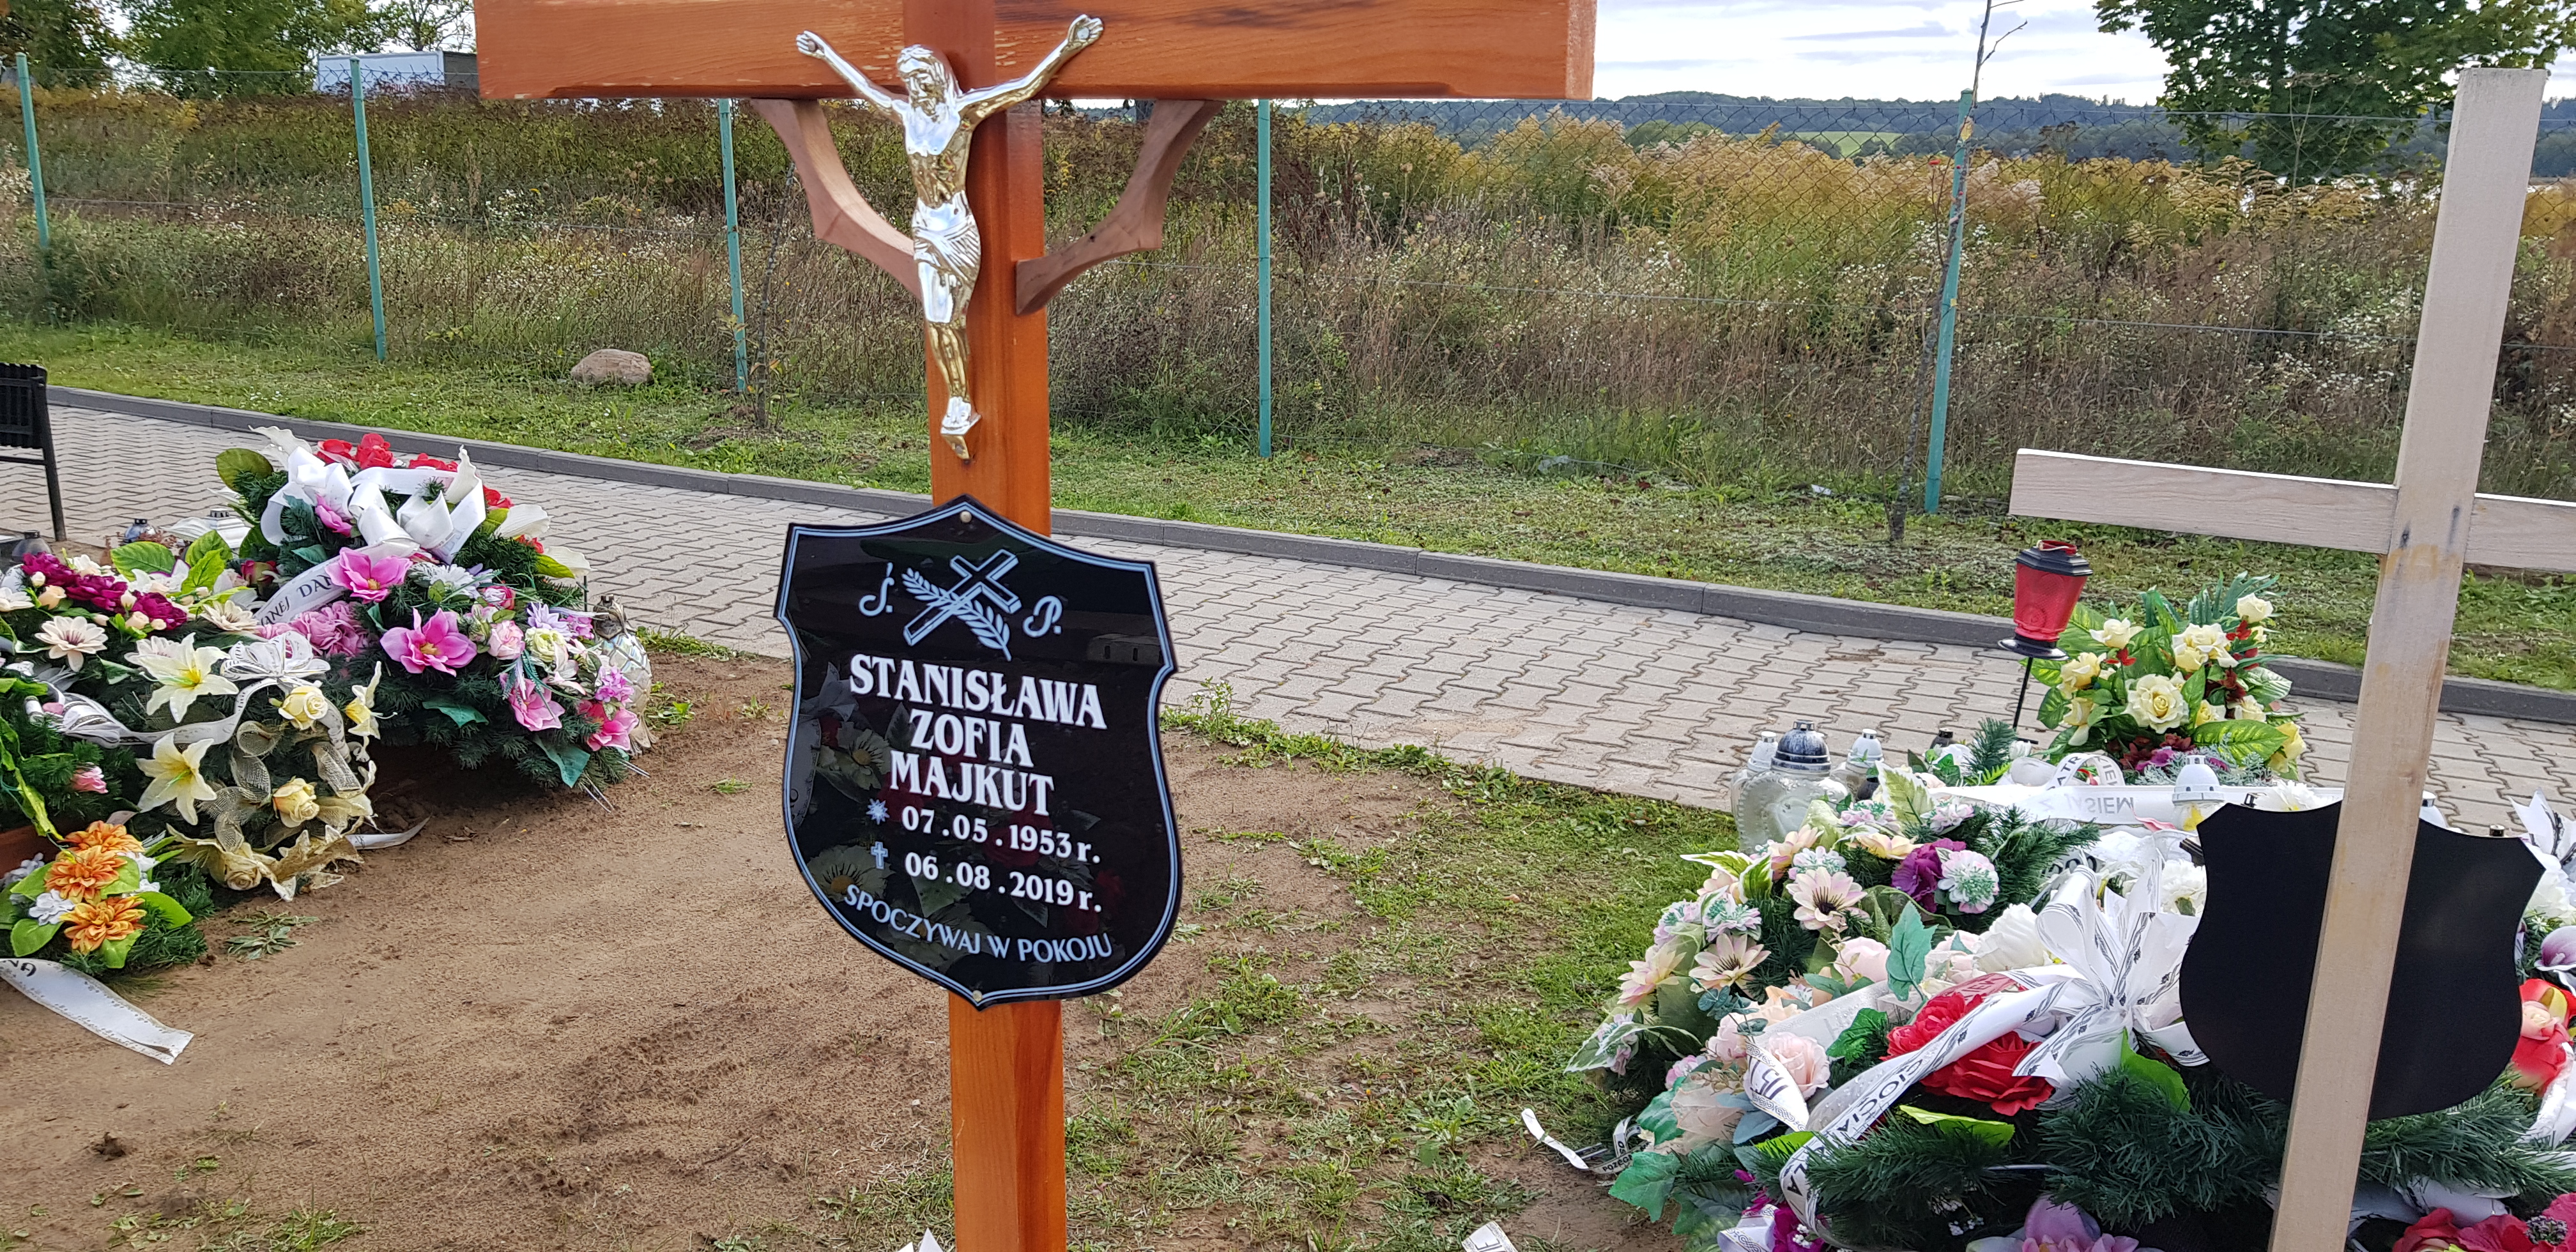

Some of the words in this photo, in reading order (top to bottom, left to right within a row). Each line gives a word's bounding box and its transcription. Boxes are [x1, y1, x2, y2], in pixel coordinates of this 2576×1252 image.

[849, 653, 1107, 730] STANISŁAWA
[908, 708, 1035, 768] ZOFIA
[889, 750, 1055, 816] MAJKUT
[843, 883, 981, 955] SPOCZYWAJ
[987, 935, 1011, 958] W
[1016, 931, 1113, 964] POKOJU
